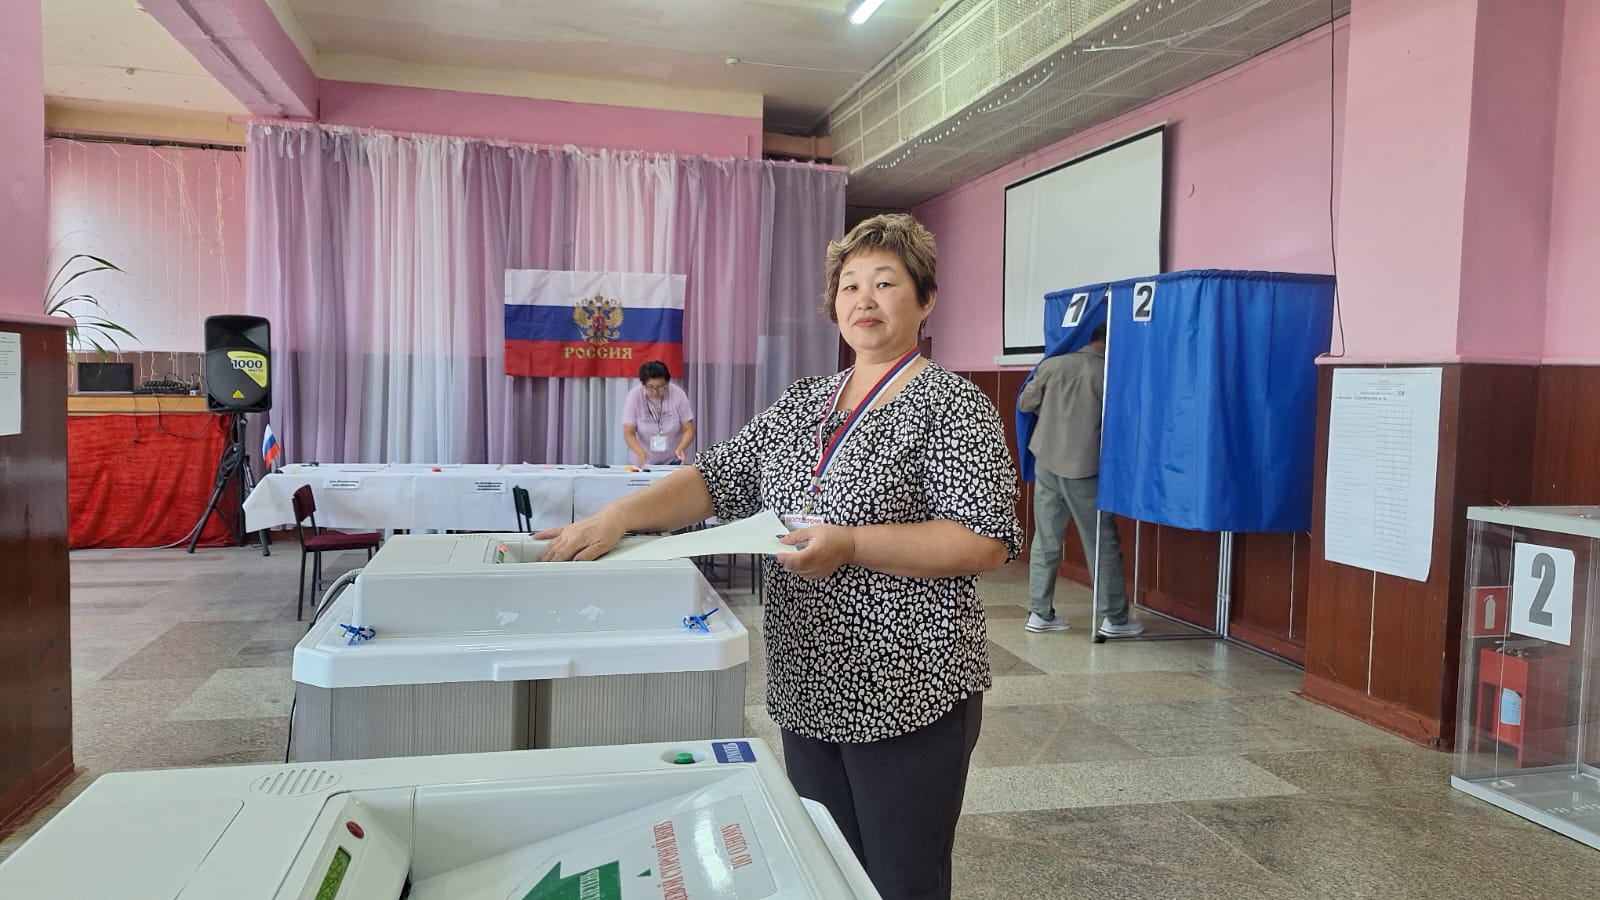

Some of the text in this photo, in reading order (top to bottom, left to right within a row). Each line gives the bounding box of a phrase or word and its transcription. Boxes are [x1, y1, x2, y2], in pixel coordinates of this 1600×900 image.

[1069, 295, 1087, 323] 1
[1134, 285, 1153, 318] 2
[232, 359, 263, 369] 1000
[564, 346, 633, 360] РОССИЯ
[1528, 552, 1557, 627] 2
[720, 823, 752, 869] ПО ОДНОМУ
